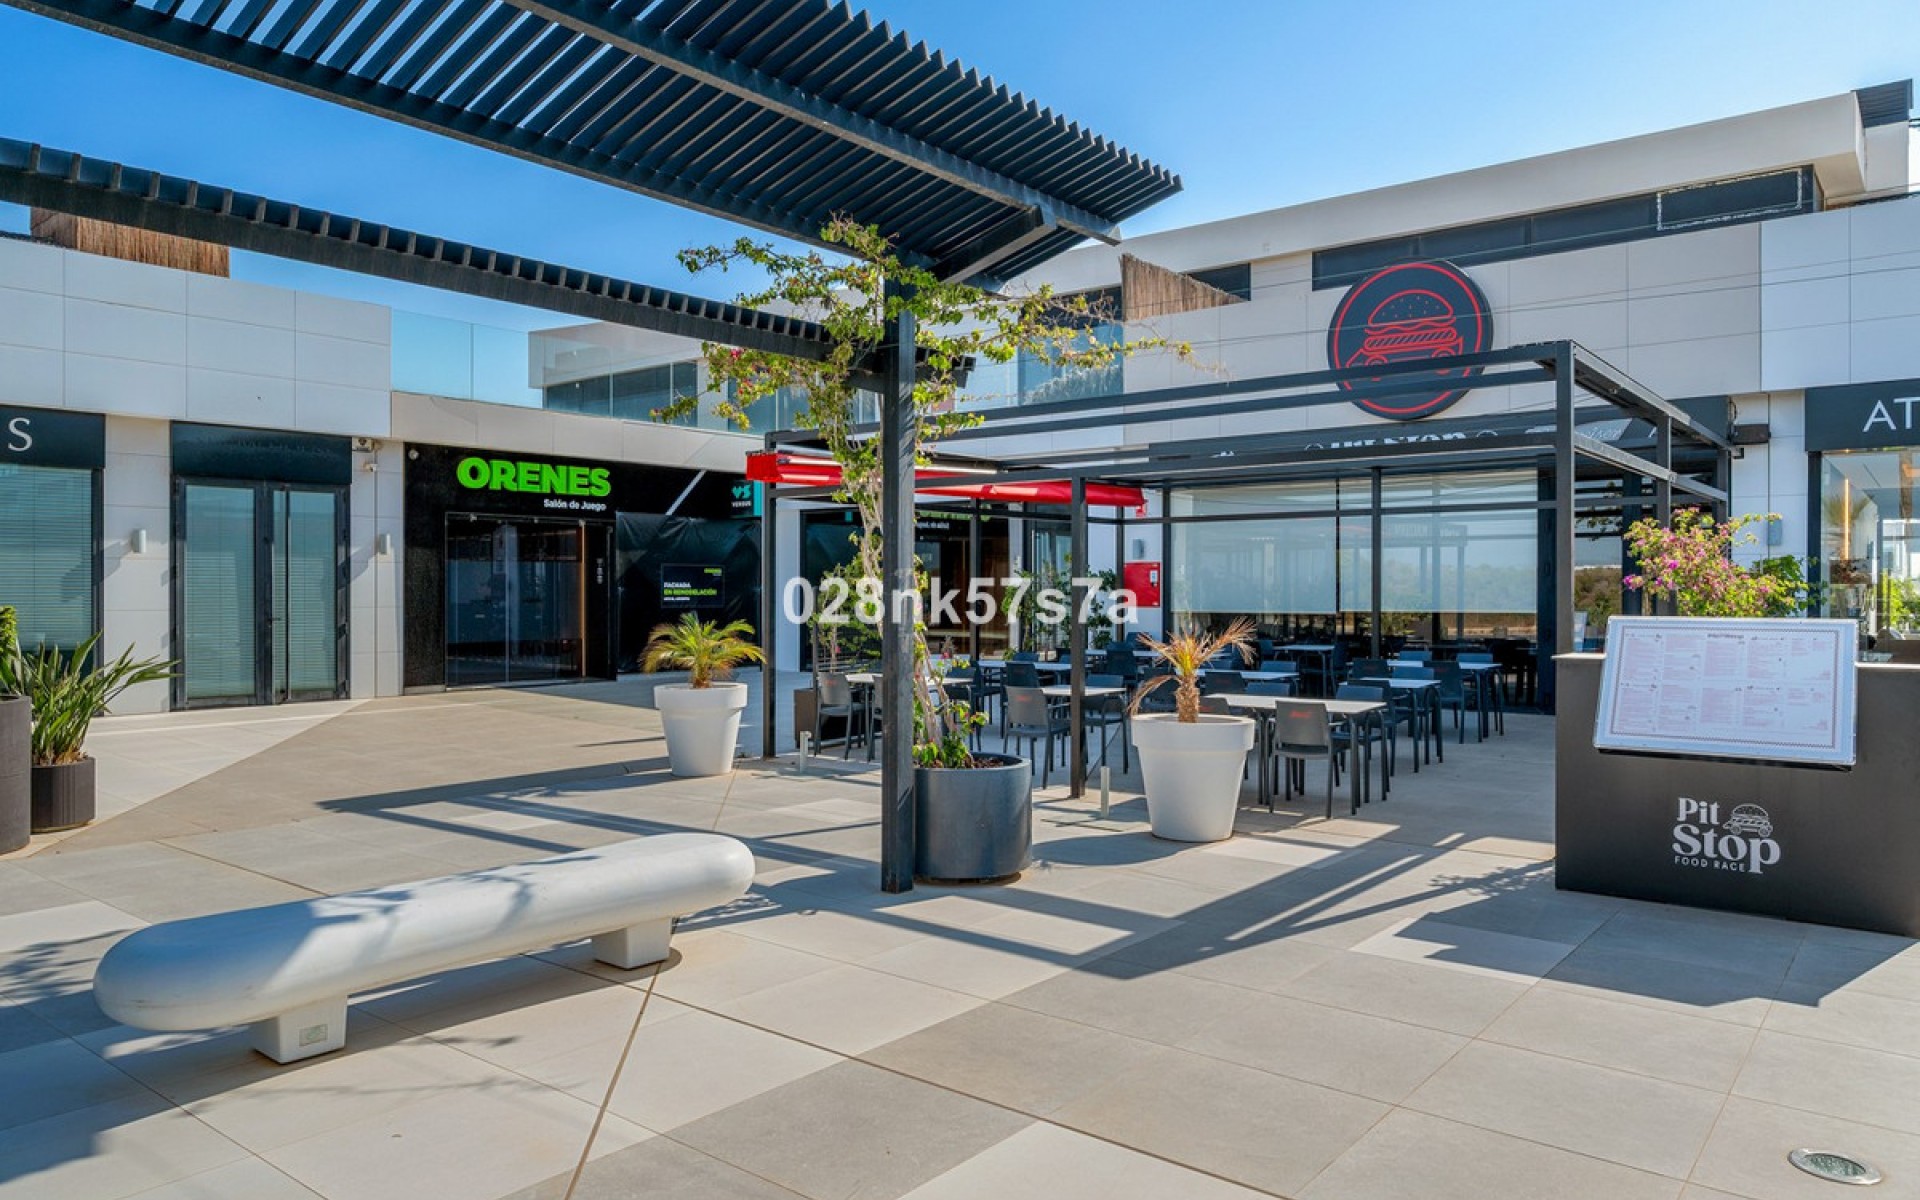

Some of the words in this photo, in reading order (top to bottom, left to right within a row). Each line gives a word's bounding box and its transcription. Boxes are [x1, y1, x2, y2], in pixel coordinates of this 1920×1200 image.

[7, 417, 33, 451] S
[456, 457, 611, 497] ORENES
[543, 498, 567, 508] Salón
[568, 500, 580, 509] de
[581, 501, 607, 512] Juego
[1677, 797, 1720, 825] Pit
[1672, 823, 1781, 874] Stop
[1674, 855, 1708, 868] FOOD
[1713, 859, 1746, 872] RACE
